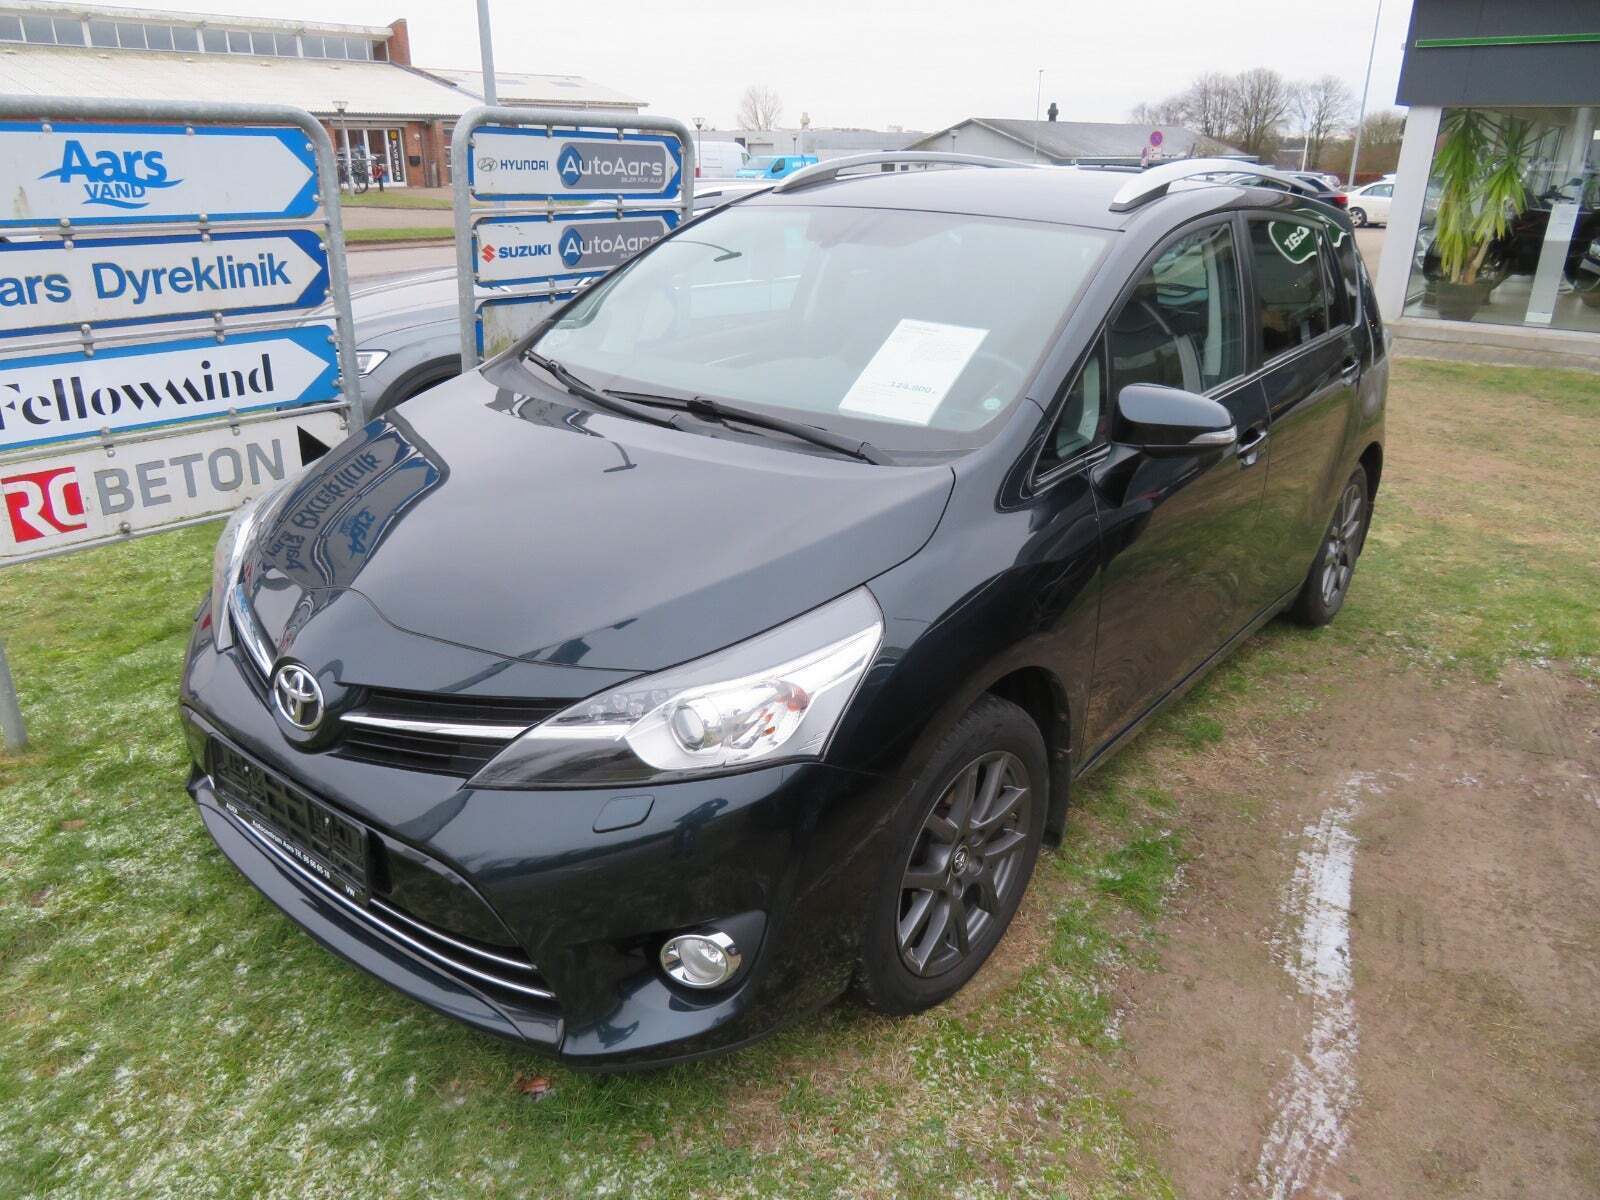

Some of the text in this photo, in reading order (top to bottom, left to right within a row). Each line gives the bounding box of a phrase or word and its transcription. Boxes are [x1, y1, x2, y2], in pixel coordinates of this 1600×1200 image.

[60, 140, 168, 187] Aars
[500, 159, 549, 171] HYUNDAI
[562, 156, 663, 176] AutoAars
[84, 183, 146, 199] VAND
[499, 244, 552, 259] SUZUKI
[92, 253, 292, 305] Dyreklinik
[94, 438, 286, 516] BETON
